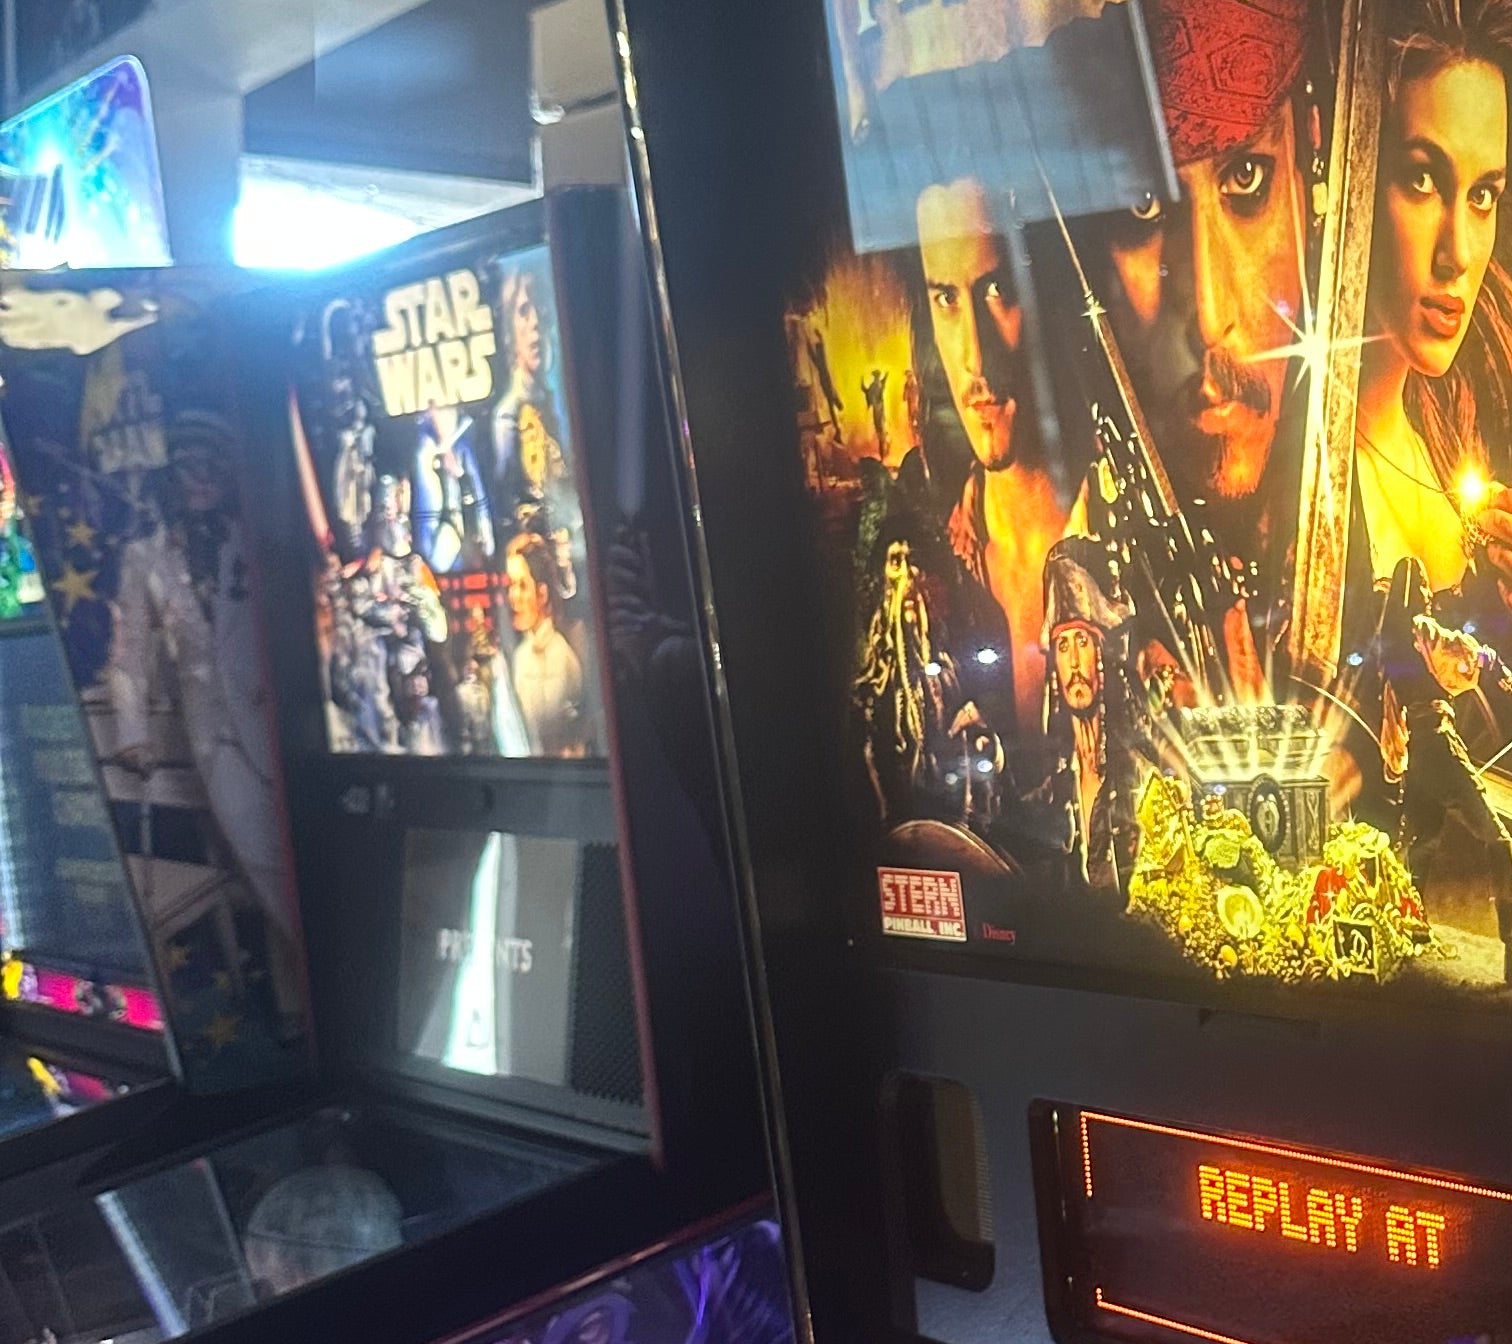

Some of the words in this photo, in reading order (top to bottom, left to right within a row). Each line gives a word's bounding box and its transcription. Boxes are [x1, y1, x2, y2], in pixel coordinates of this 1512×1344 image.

[372, 269, 493, 356] STAR
[375, 330, 496, 417] WARS
[882, 873, 961, 917] STERN
[1198, 1164, 1363, 1253] REPLAY
[1386, 1205, 1446, 1269] AT
